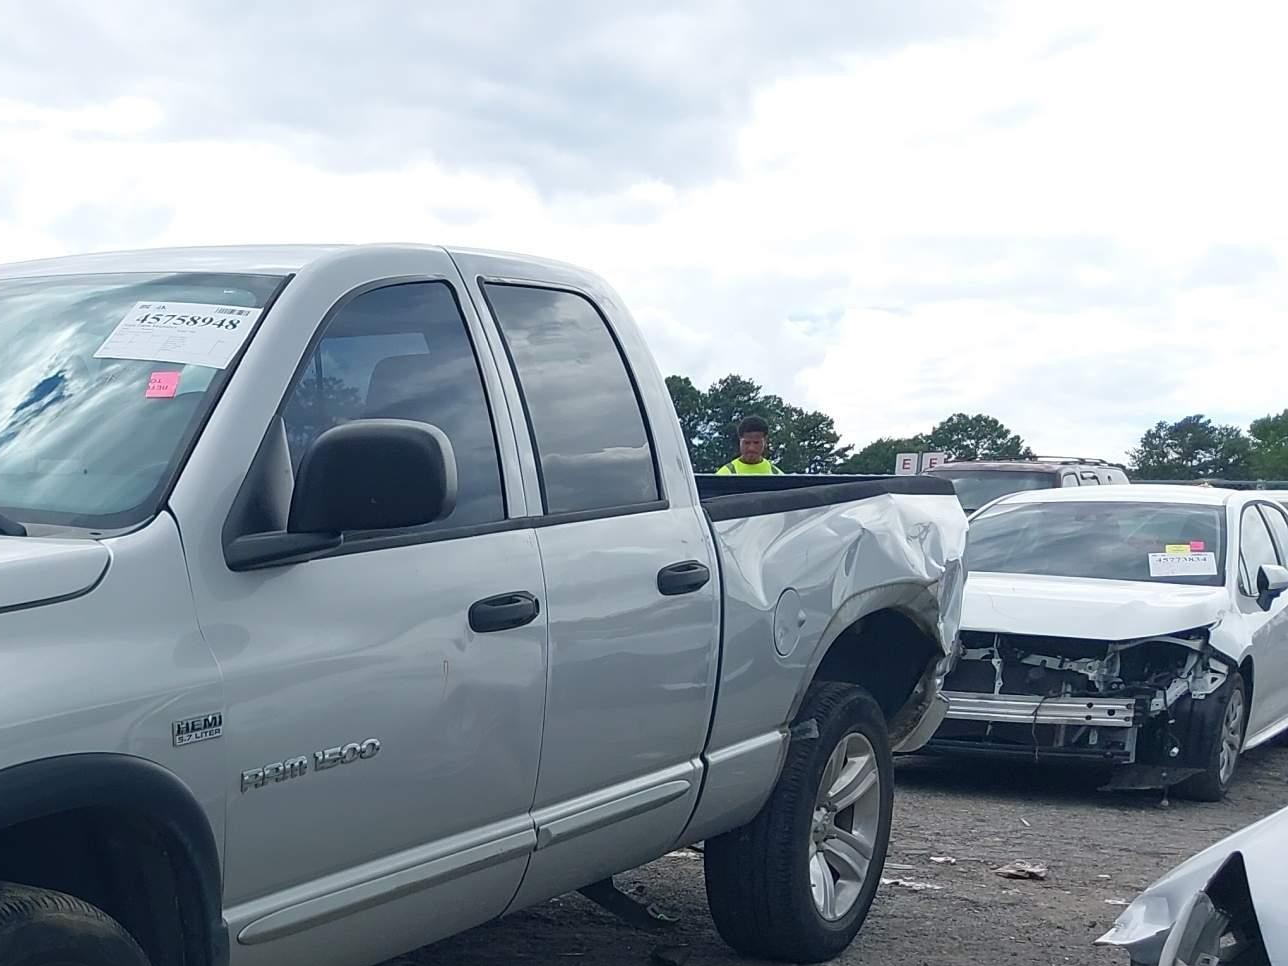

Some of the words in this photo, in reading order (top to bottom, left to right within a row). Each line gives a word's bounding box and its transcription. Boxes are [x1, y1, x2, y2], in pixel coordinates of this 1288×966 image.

[136, 312, 241, 330] 45758948
[902, 458, 911, 470] E
[176, 714, 223, 735] HEMI
[177, 734, 192, 744] 5.7
[195, 728, 221, 739] LITER
[240, 755, 309, 793] RAM
[313, 738, 382, 772] 1500
